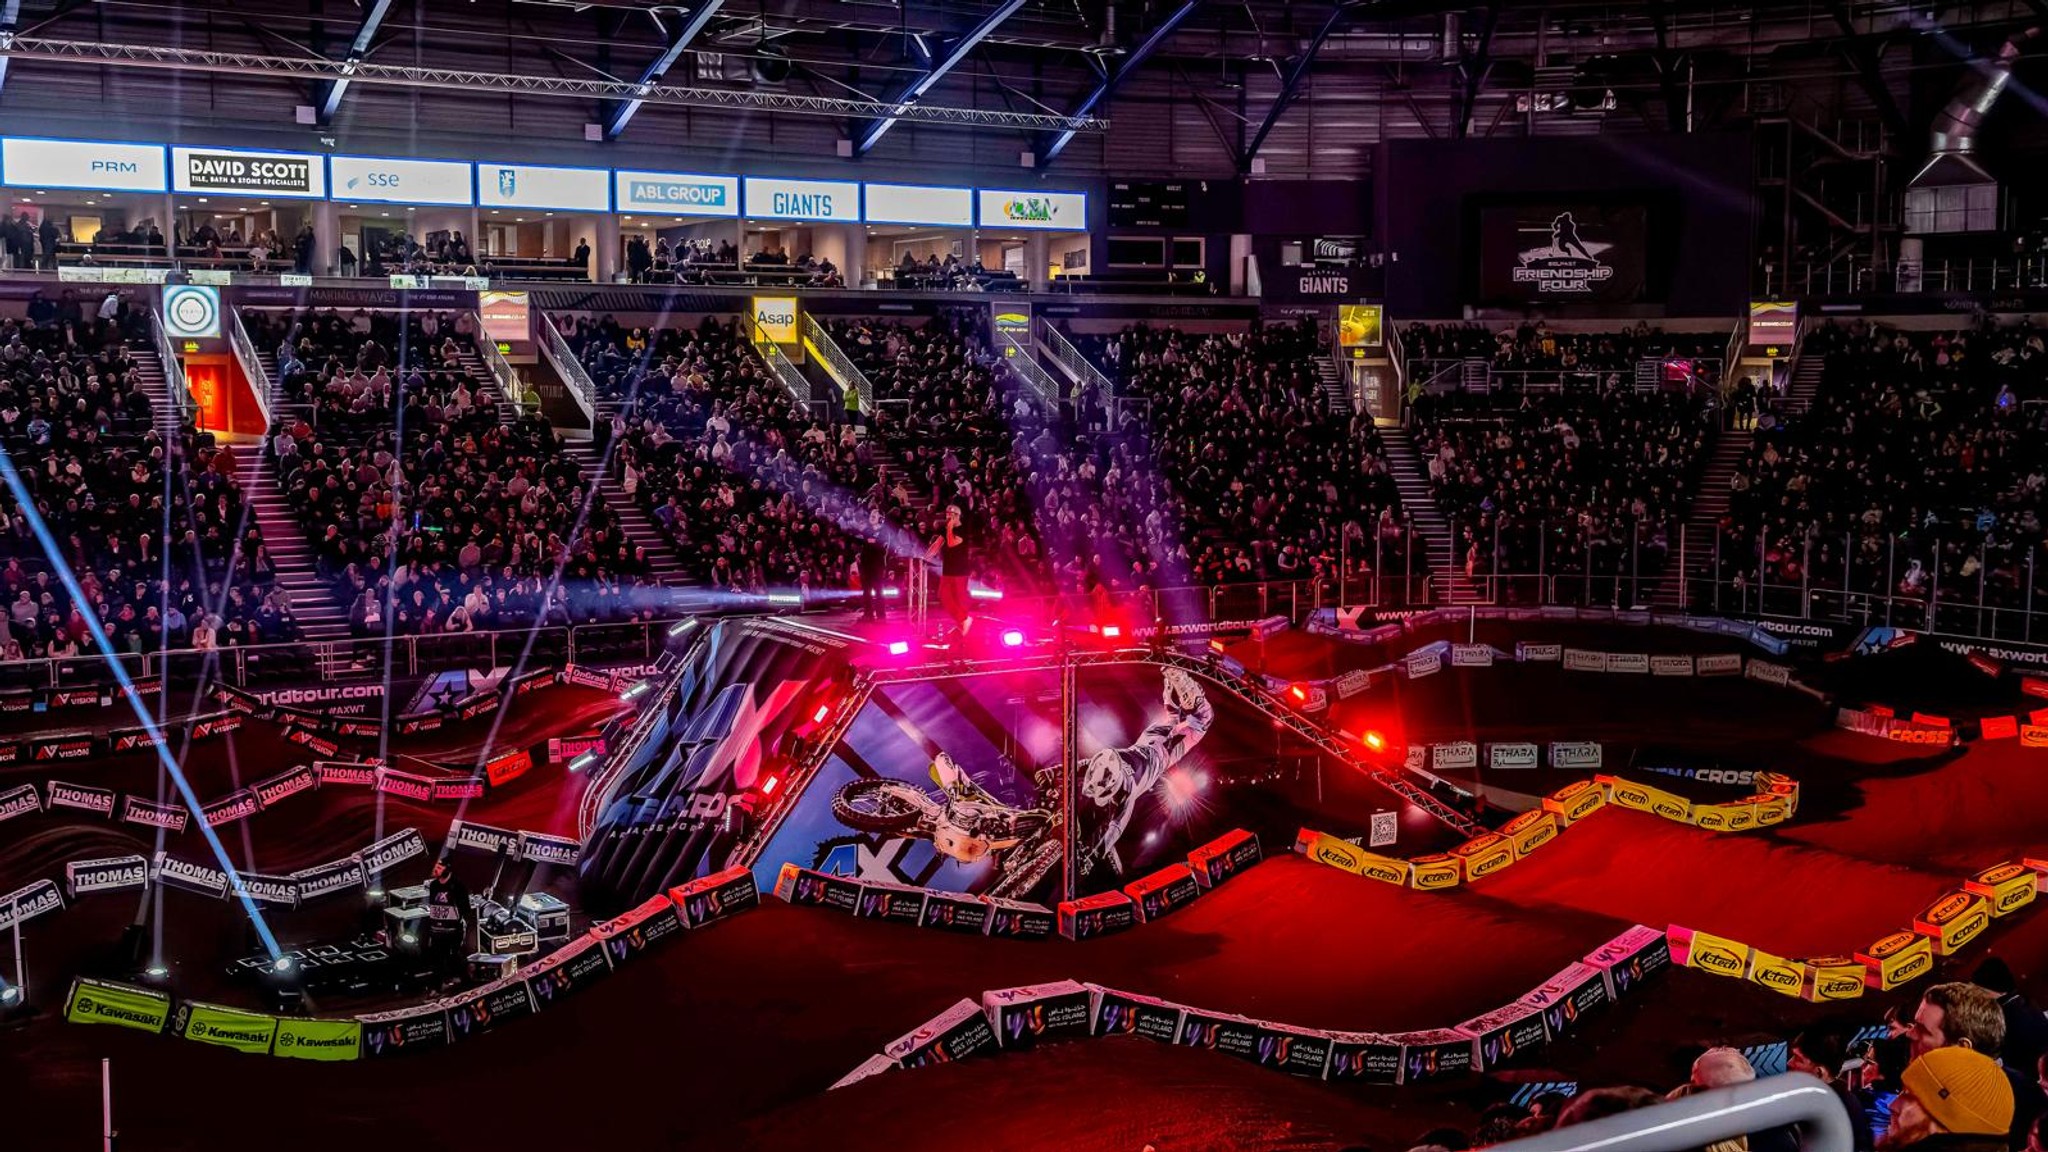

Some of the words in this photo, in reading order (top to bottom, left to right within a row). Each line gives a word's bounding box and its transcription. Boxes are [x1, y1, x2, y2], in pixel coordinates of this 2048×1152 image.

[92, 160, 137, 173] PRM
[190, 159, 245, 176] DAVID
[251, 162, 307, 179] SCOTT
[263, 178, 306, 187] SPECIALISTS
[367, 172, 399, 187] sse
[635, 184, 668, 200] ABL
[668, 187, 722, 204] GROUP
[774, 192, 832, 216] GIANTS
[1515, 268, 1612, 279] FRIENDSHIP
[1299, 276, 1349, 293] GIANTS
[1541, 280, 1587, 291] FOUR
[757, 309, 794, 327] Asap
[1453, 649, 1491, 658] ETHARA
[1566, 652, 1604, 663] ETHARA
[1609, 655, 1647, 665] ETHARA
[572, 668, 610, 685] OnGrade
[136, 686, 162, 695] VISION
[71, 697, 97, 705] VISION
[328, 704, 366, 716] #AXWT
[213, 722, 241, 734] VISION
[59, 748, 90, 758] VISION
[562, 738, 605, 753] THOMAS
[1435, 745, 1474, 758] ETHARA
[1493, 748, 1534, 759] ETHARA
[1555, 748, 1599, 758] ETHARA
[322, 767, 373, 781] THOMAS
[260, 772, 312, 801] THOMAS
[384, 778, 431, 797] THOMAS
[435, 784, 484, 796] THOMAS
[54, 787, 113, 807] THOMAS
[1573, 795, 1600, 815] K-tech
[1619, 790, 1647, 805] K-tech
[127, 805, 185, 825] THOMAS
[204, 798, 255, 824] THOMAS
[1656, 803, 1682, 817] K-tech
[461, 827, 518, 849] THOMAS
[1523, 825, 1552, 848] K-tech
[364, 835, 422, 873] THOMAS
[526, 841, 579, 860] THOMAS
[1322, 848, 1353, 867] K-tech
[1477, 852, 1507, 872] K-tech
[75, 865, 144, 887] THOMAS
[164, 857, 227, 884] THOMAS
[1367, 866, 1398, 882] K-tech
[1423, 871, 1454, 882] K-tech
[1986, 866, 2020, 882] K-tech
[301, 868, 362, 893] THOMAS
[2001, 887, 2030, 907] K-tech
[1933, 896, 1966, 920] K-tech
[1952, 915, 1984, 944] K-tech
[1875, 935, 1911, 953] K-tech
[1699, 950, 1738, 971] K-tech
[1892, 956, 1926, 981] K-tech
[1760, 968, 1798, 986] K-tech
[1823, 982, 1859, 993] K-tech
[96, 1003, 161, 1026] Kawasaki
[1048, 1014, 1062, 1023] YAS
[1063, 1010, 1087, 1021] ISLAND
[207, 1025, 269, 1043] Kawasaki
[1150, 1022, 1173, 1033] ISLAND
[296, 1035, 357, 1047] Kawasaki
[952, 1041, 965, 1054] YAS
[966, 1029, 989, 1047] ISLAND
[1231, 1037, 1252, 1047] ISLAND
[1302, 1052, 1323, 1062] ISLAND
[1451, 1057, 1469, 1065] ISLAND
